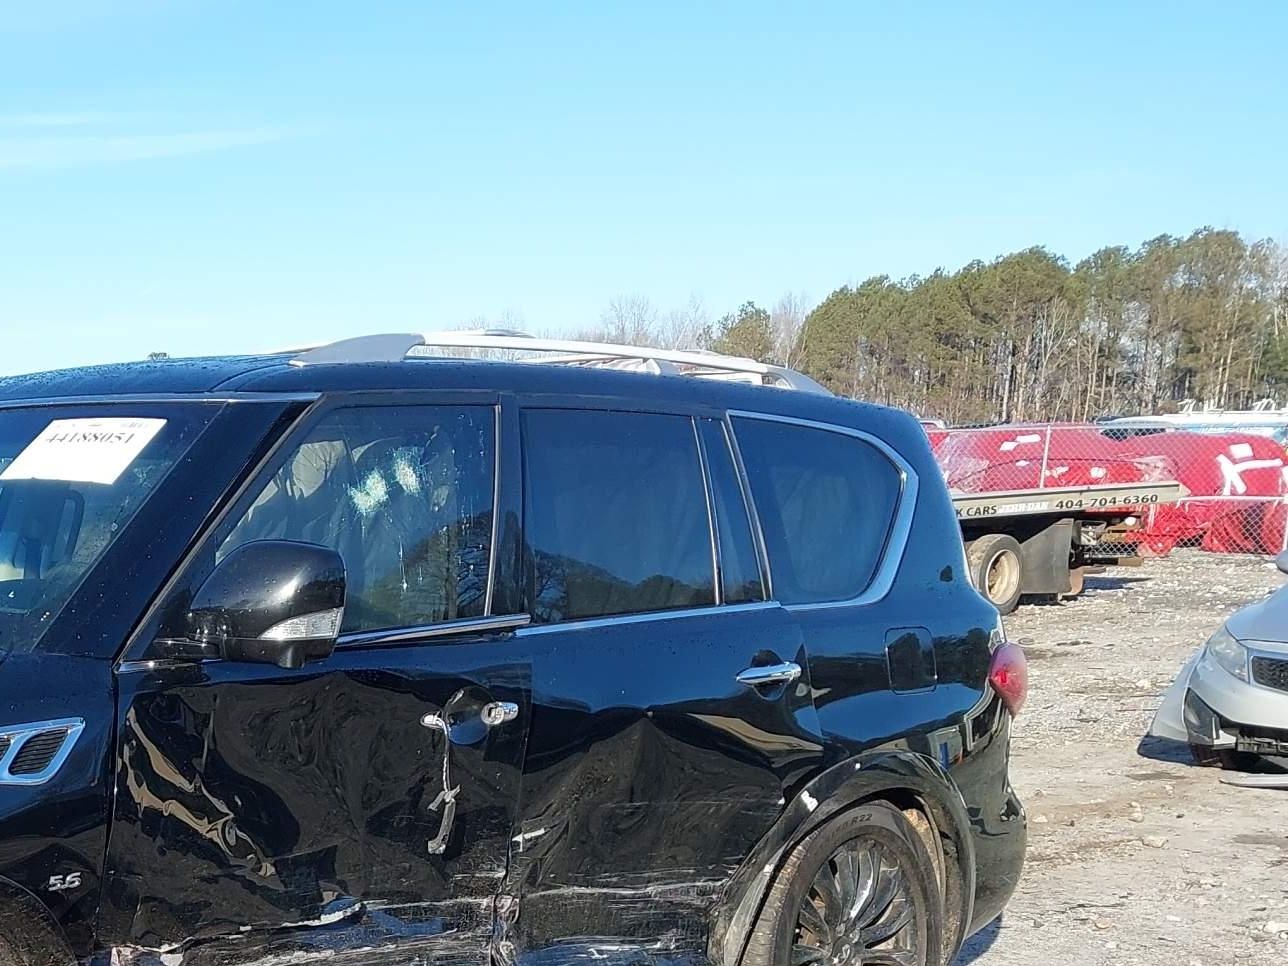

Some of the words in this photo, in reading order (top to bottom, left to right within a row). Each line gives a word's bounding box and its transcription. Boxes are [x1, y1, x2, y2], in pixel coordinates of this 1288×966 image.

[46, 432, 136, 444] 44188051
[1055, 494, 1159, 510] 404-704-6360
[966, 505, 997, 517] CARS
